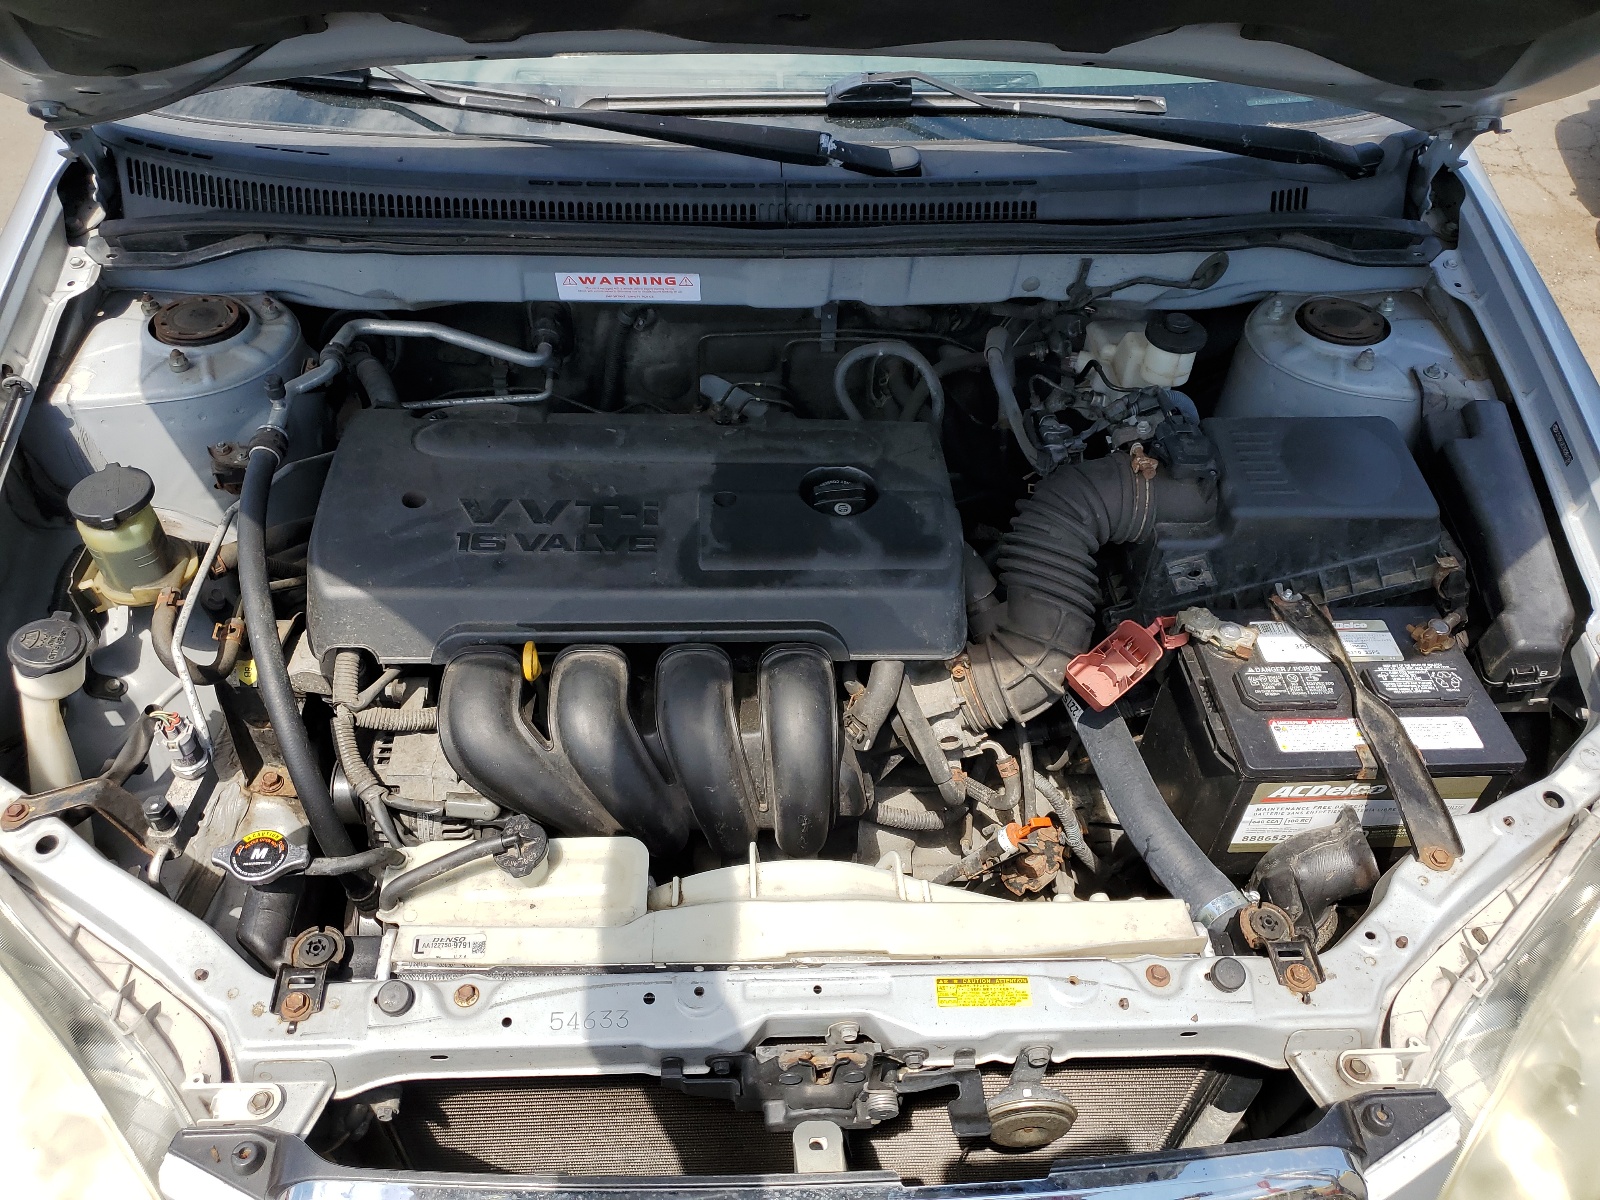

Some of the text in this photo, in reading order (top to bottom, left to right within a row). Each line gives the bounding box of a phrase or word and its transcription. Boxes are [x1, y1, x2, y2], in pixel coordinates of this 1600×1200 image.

[578, 276, 677, 285] WARNING
[458, 499, 659, 527] VVT-i
[456, 532, 658, 554] 16 VALVE
[1269, 784, 1388, 798] ACDelco
[414, 938, 425, 954] L
[549, 1009, 629, 1031] 54633
